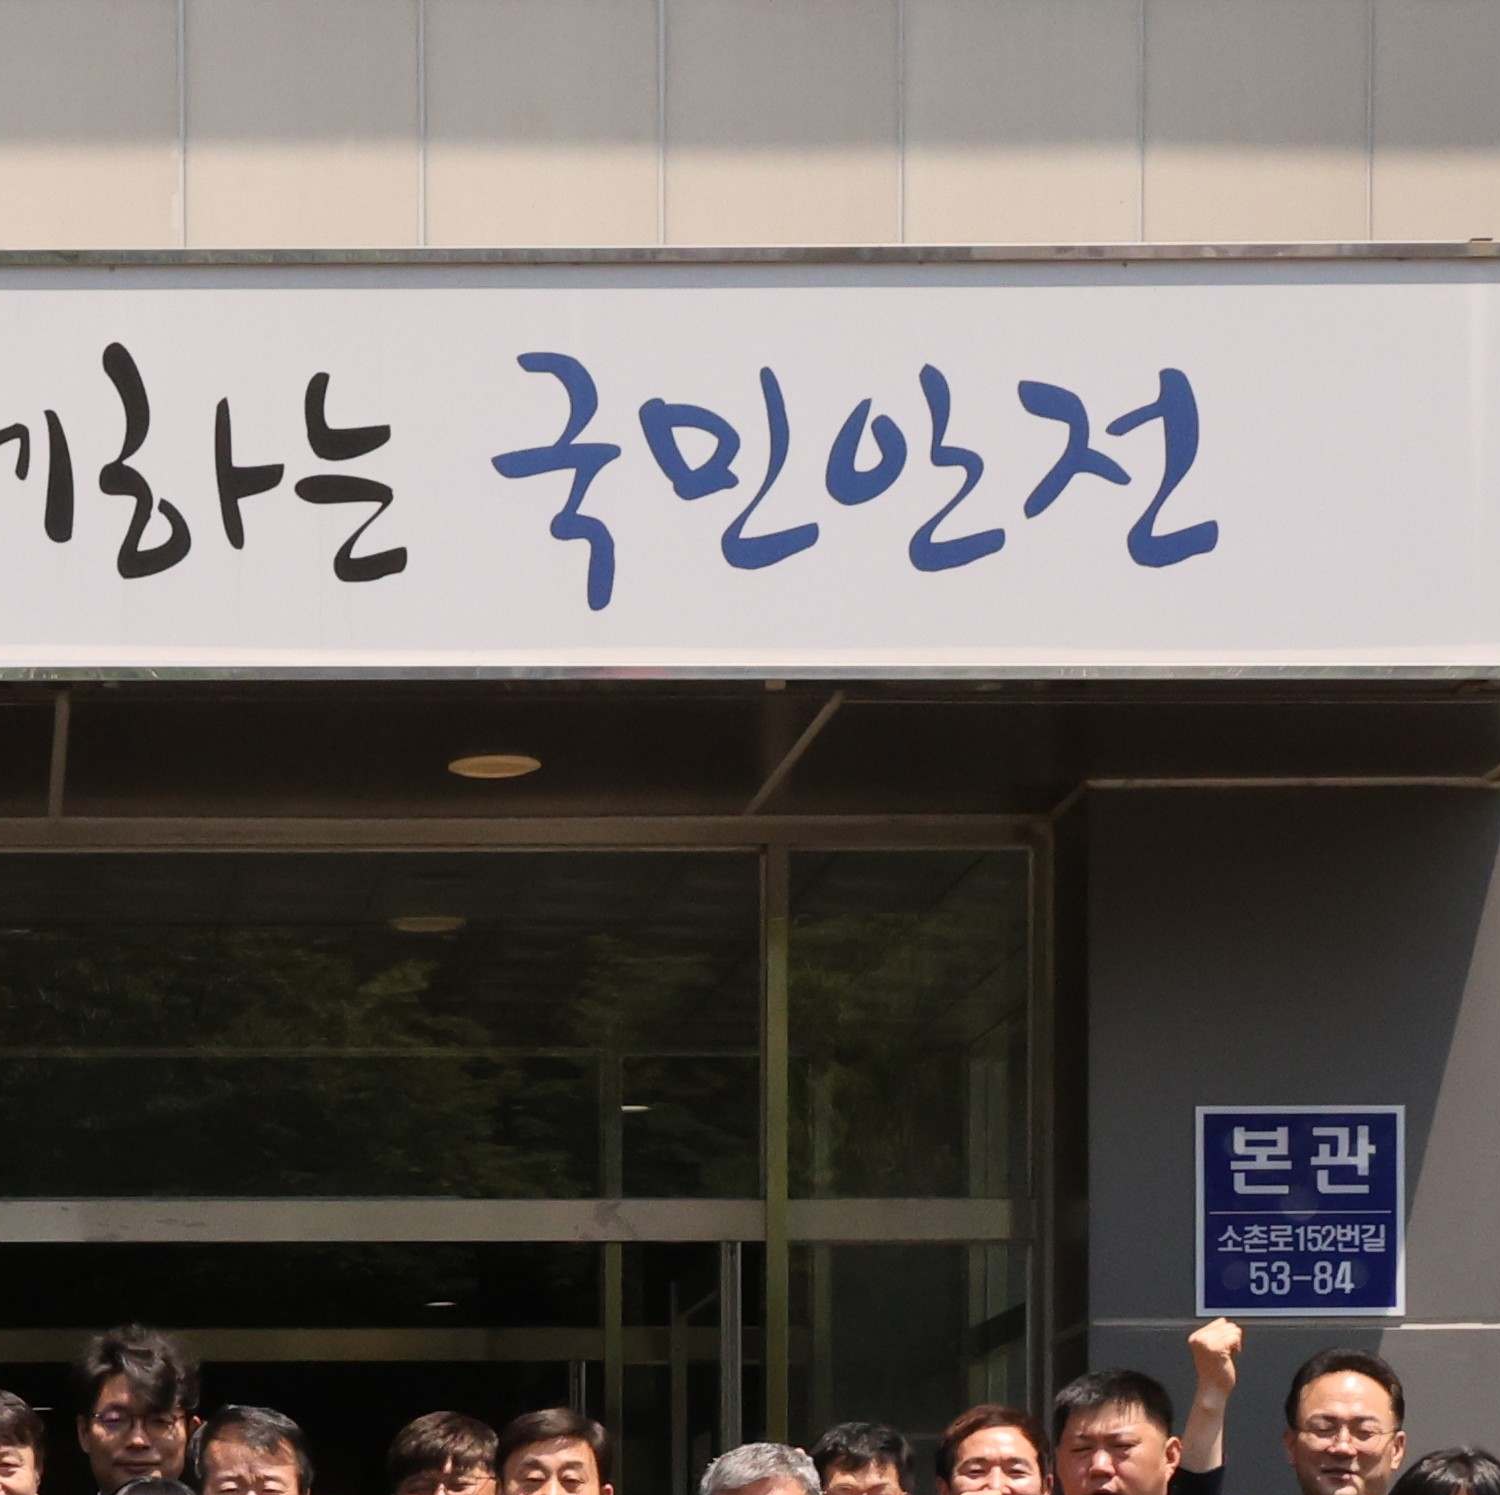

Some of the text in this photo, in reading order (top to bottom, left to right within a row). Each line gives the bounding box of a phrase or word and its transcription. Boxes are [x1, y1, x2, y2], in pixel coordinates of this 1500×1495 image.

[492, 353, 1218, 611] 국민안전
[1217, 1224, 1386, 1253] 소촌로152번길
[1250, 1261, 1355, 1295] 53-84
